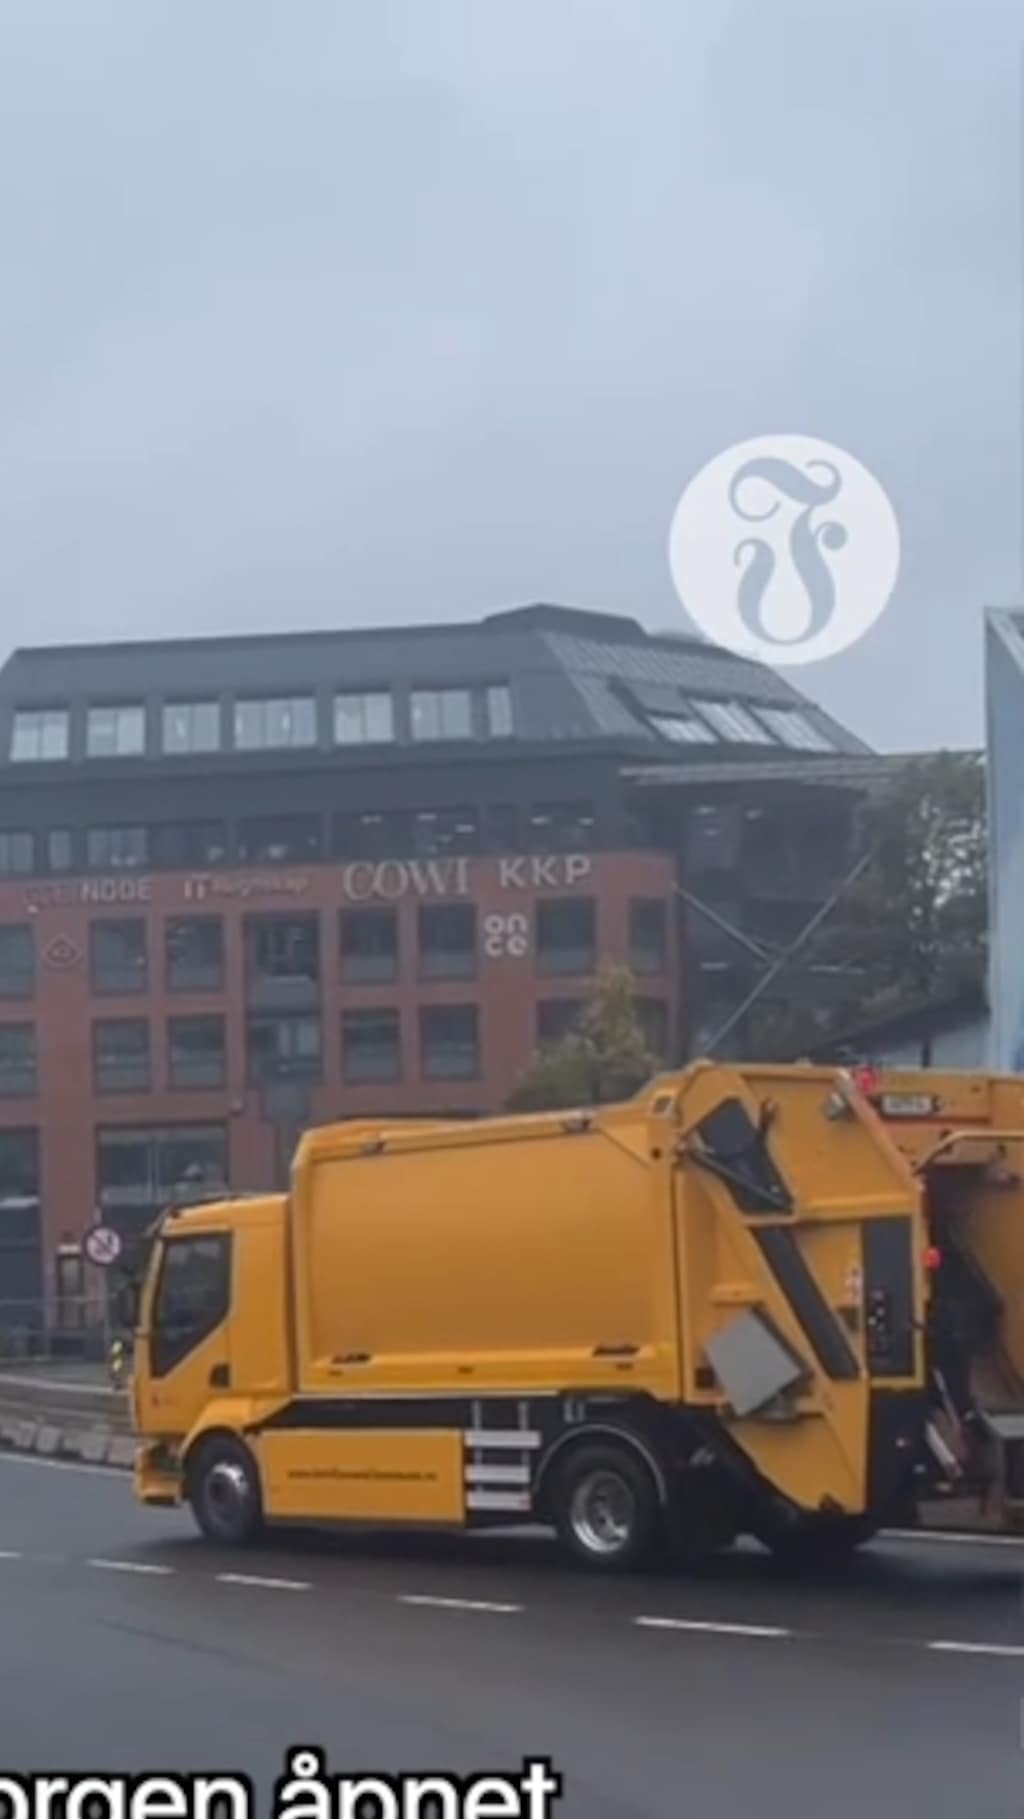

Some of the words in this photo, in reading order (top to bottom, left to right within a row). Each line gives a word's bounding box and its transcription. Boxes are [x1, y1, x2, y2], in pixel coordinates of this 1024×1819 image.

[183, 874, 212, 899] IT
[343, 857, 471, 899] COWI
[499, 854, 592, 889] KKP
